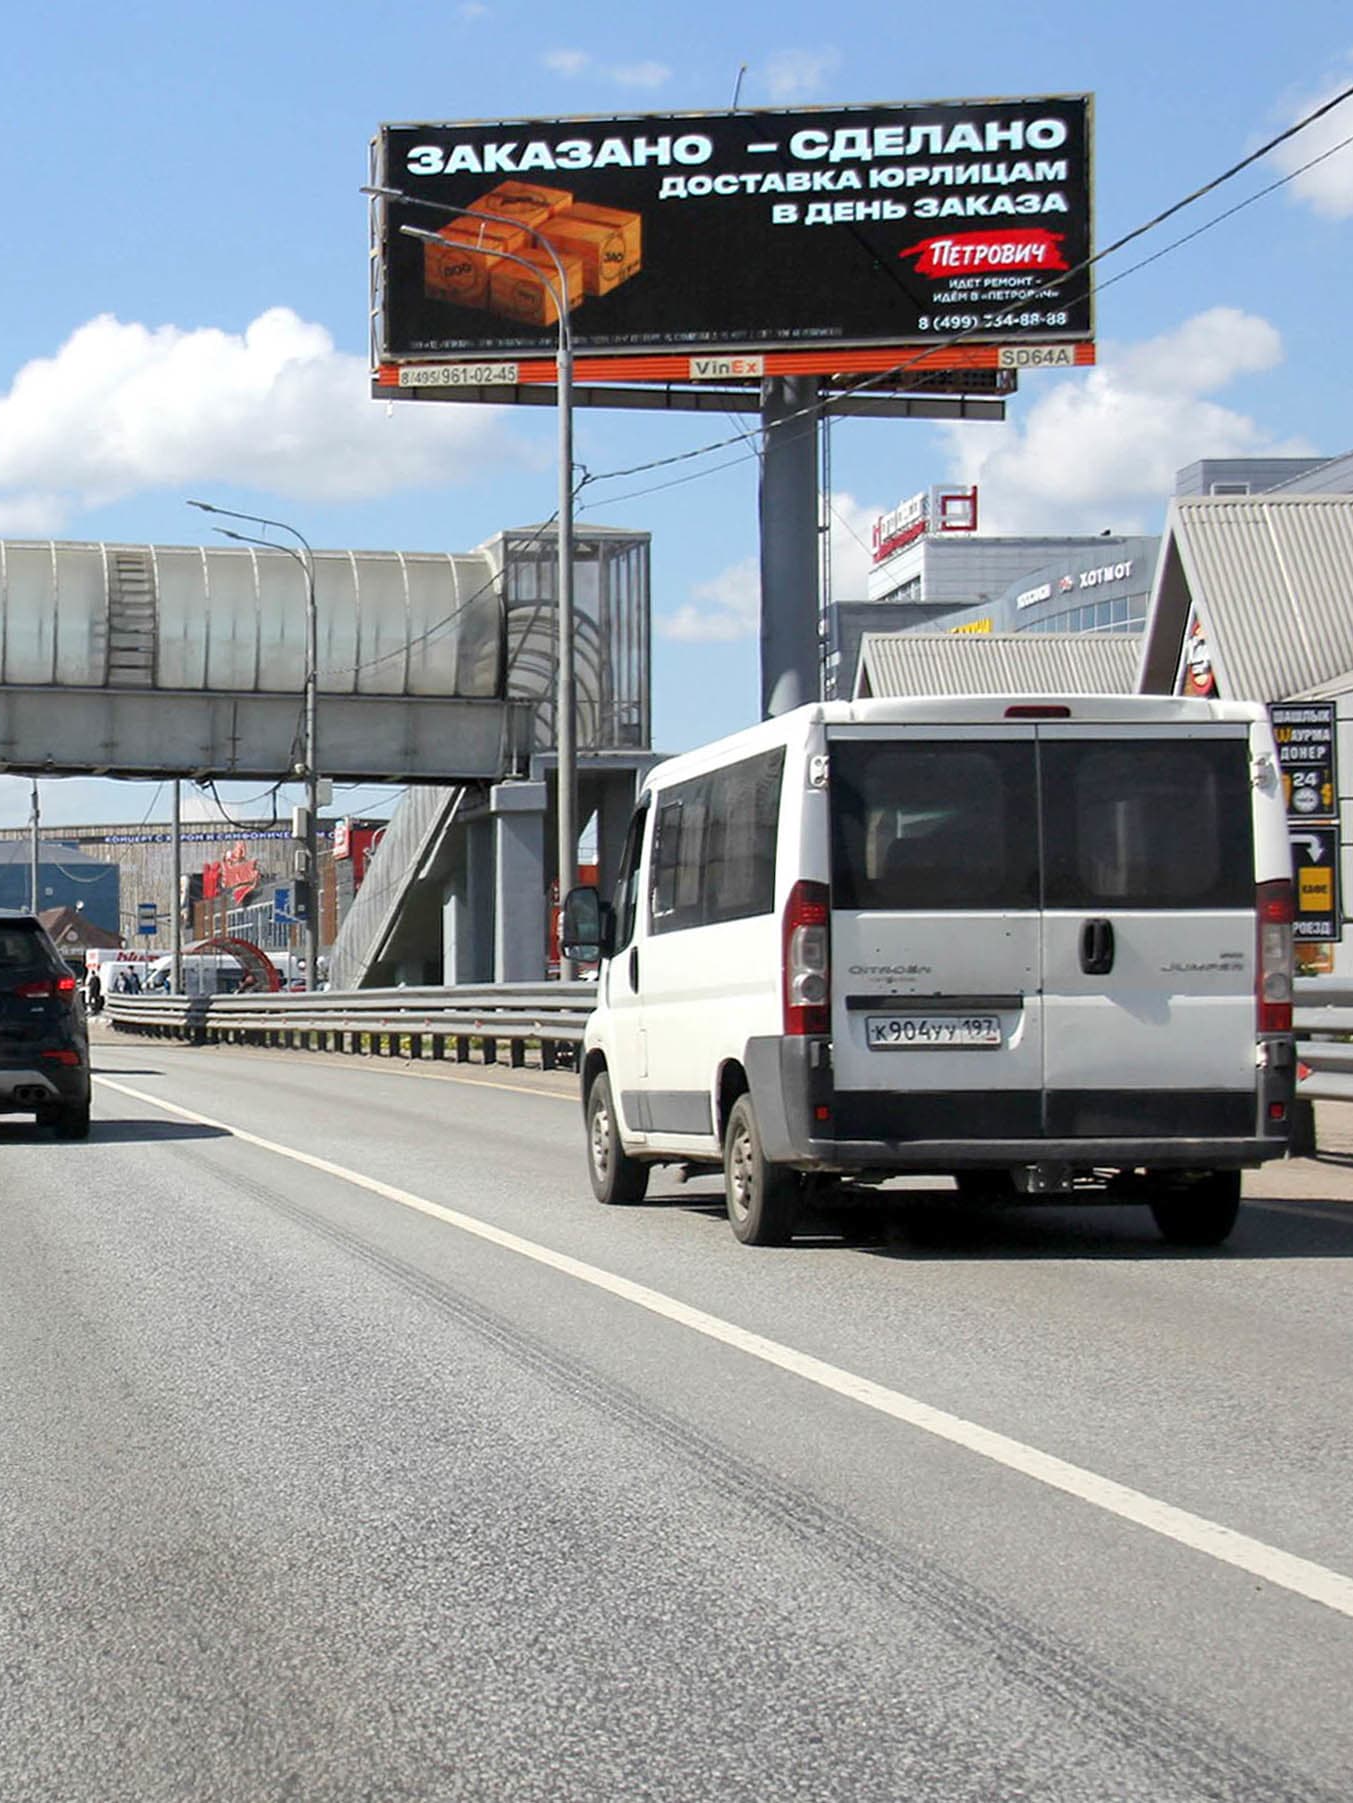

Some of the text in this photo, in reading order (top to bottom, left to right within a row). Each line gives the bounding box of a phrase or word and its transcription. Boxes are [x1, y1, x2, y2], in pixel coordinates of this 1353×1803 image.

[406, 134, 713, 175] ЗАКАЗАНО
[789, 119, 1068, 162] СДЕЛАНО
[658, 160, 1068, 200] ДОСТАВКА ЮРЛИЦАМ
[772, 191, 1069, 226] В ДЕНЬ ЗАКАЗА
[983, 276, 1034, 288] РЕМОНТ
[918, 316, 929, 330] 8
[933, 315, 979, 331] (499)
[1001, 349, 1070, 365] SD64A
[695, 359, 757, 375] VinEx
[1272, 709, 1331, 723] ШАШЛЫК
[1280, 745, 1327, 761] ДОНЕР
[1292, 771, 1318, 787] 24
[1293, 920, 1331, 936] РОЕЗД
